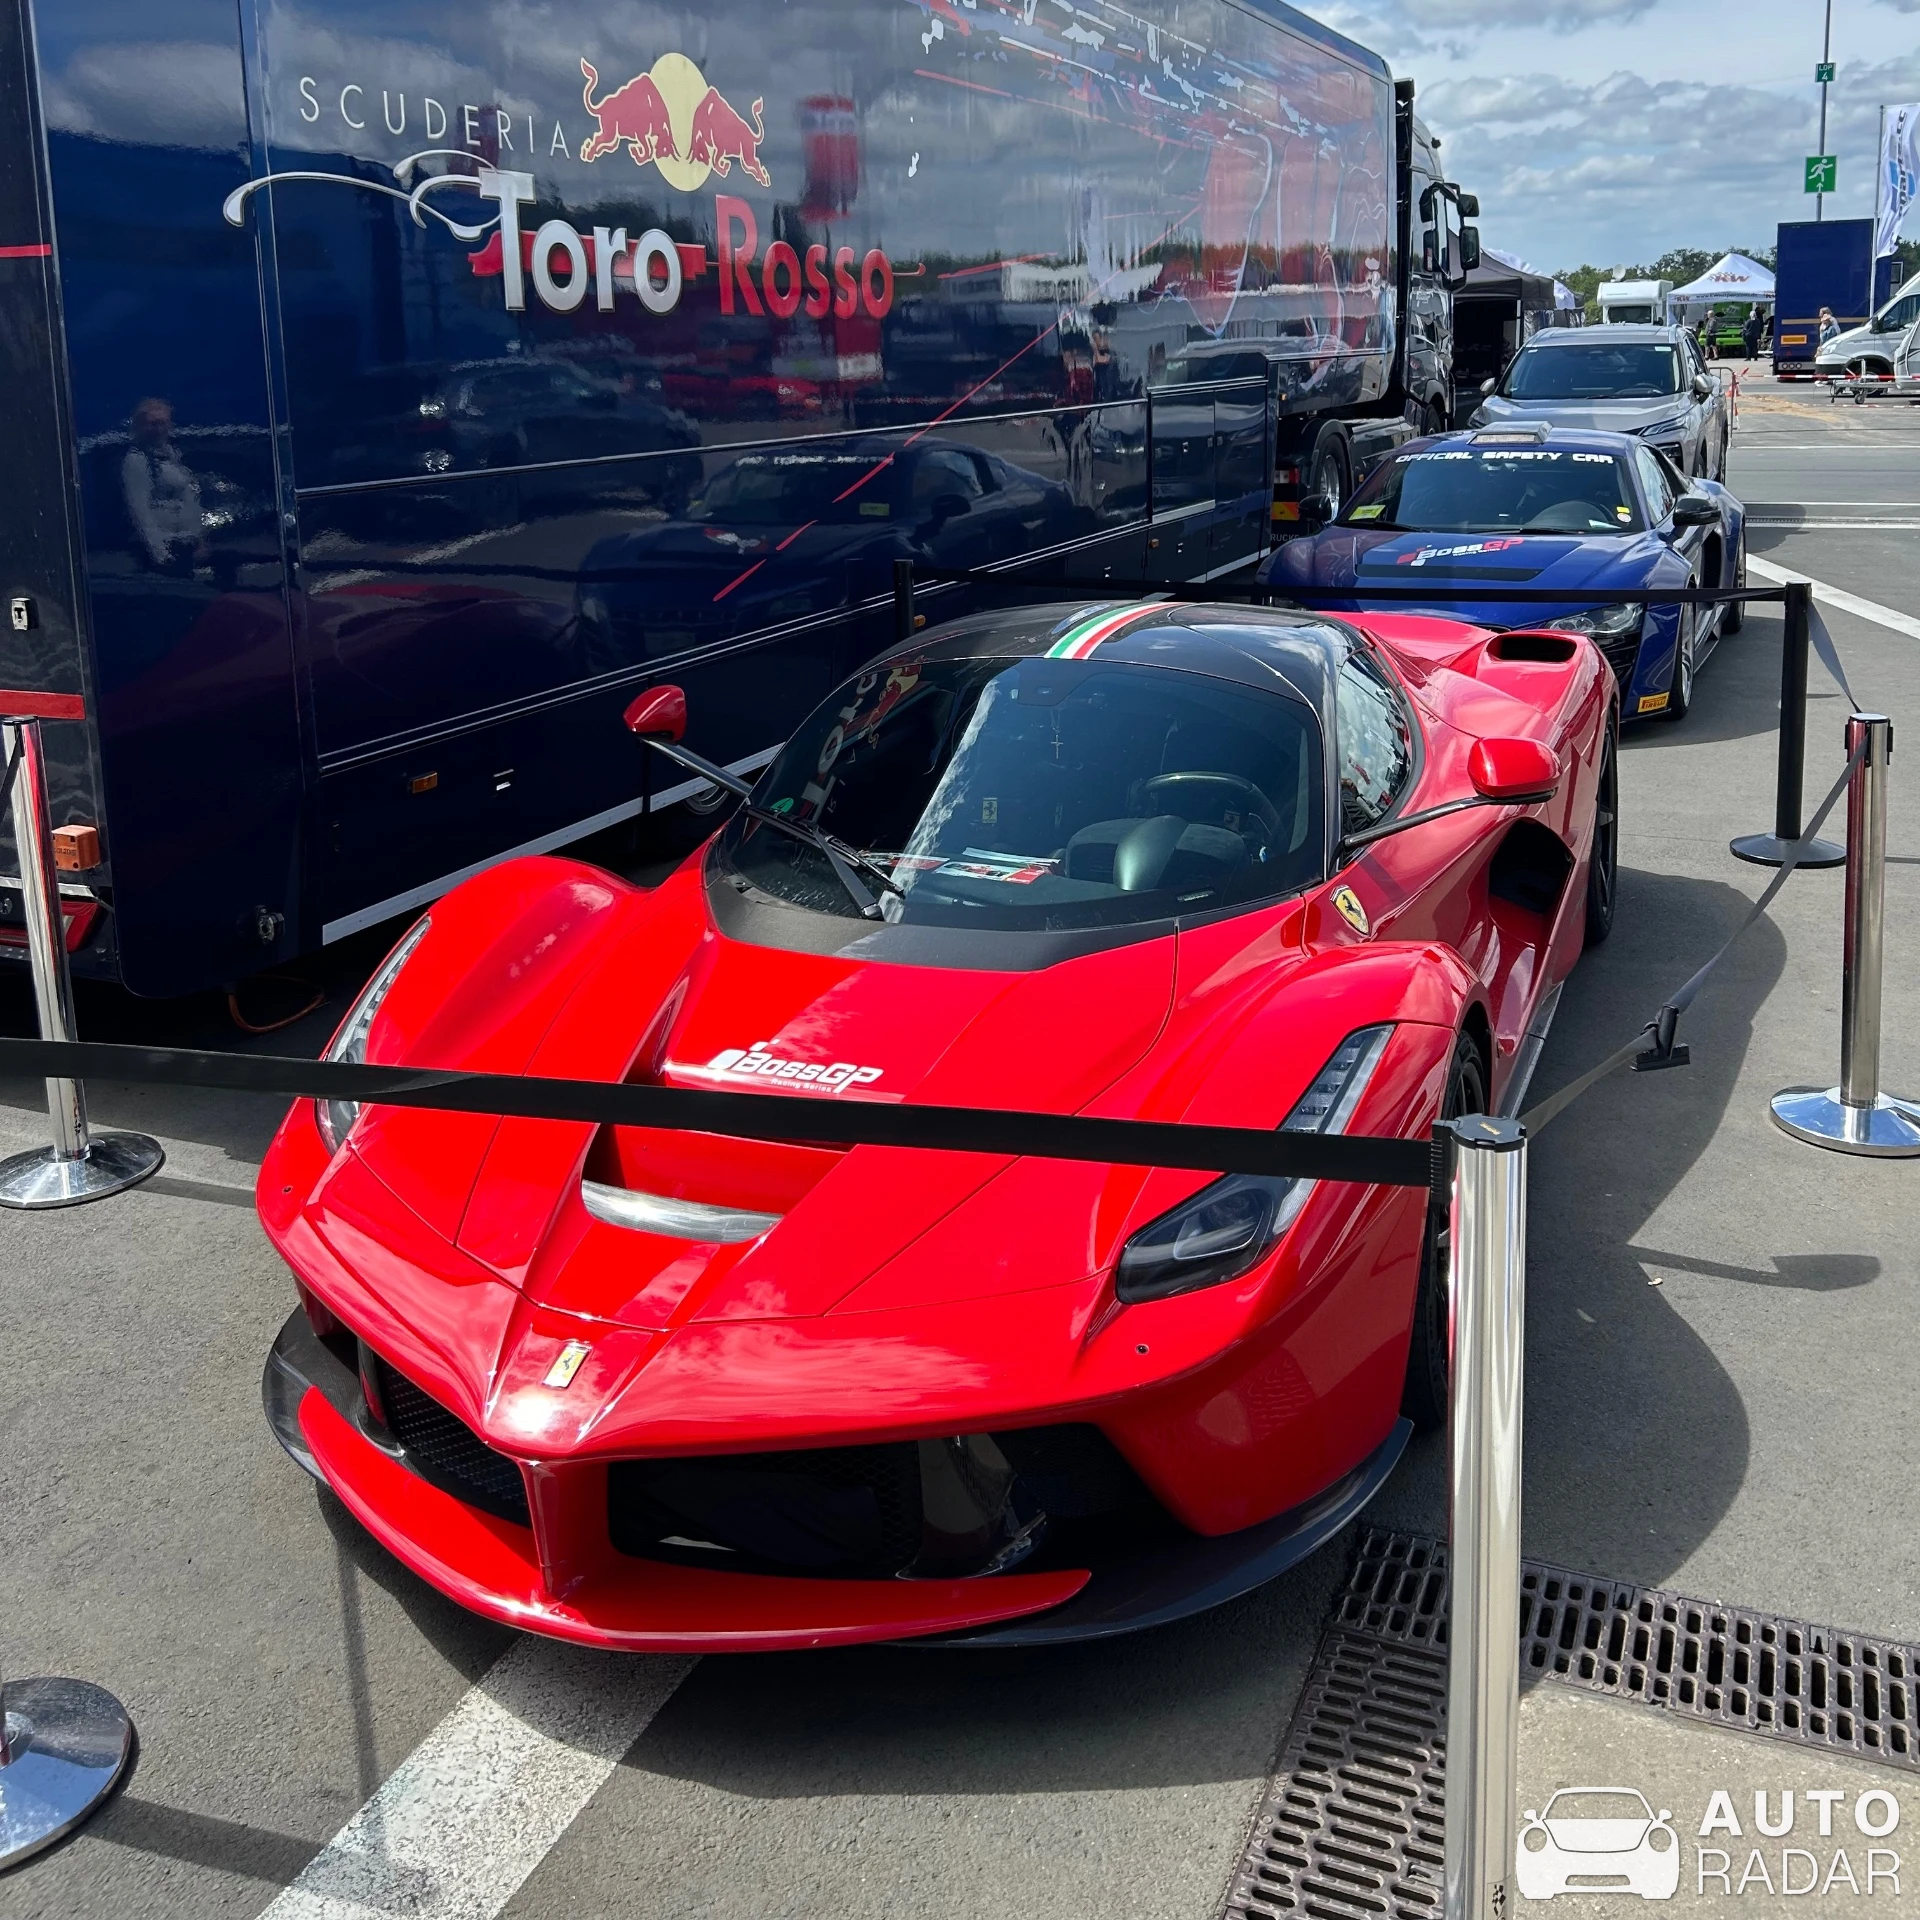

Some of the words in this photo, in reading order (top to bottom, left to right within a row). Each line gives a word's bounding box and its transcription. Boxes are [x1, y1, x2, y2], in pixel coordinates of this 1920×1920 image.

[1821, 71, 1829, 81] 4
[300, 76, 570, 159] SCUDERIA
[479, 168, 682, 314] Toro
[715, 194, 895, 320] Rosso
[1395, 452, 1473, 464] OFFICIAL
[1482, 452, 1562, 461] SAFETY
[1572, 453, 1613, 464] CAR
[1415, 537, 1524, 560] BossGP
[731, 1051, 884, 1094] BossGP
[771, 1077, 801, 1089] Racing
[803, 1082, 832, 1093] Series
